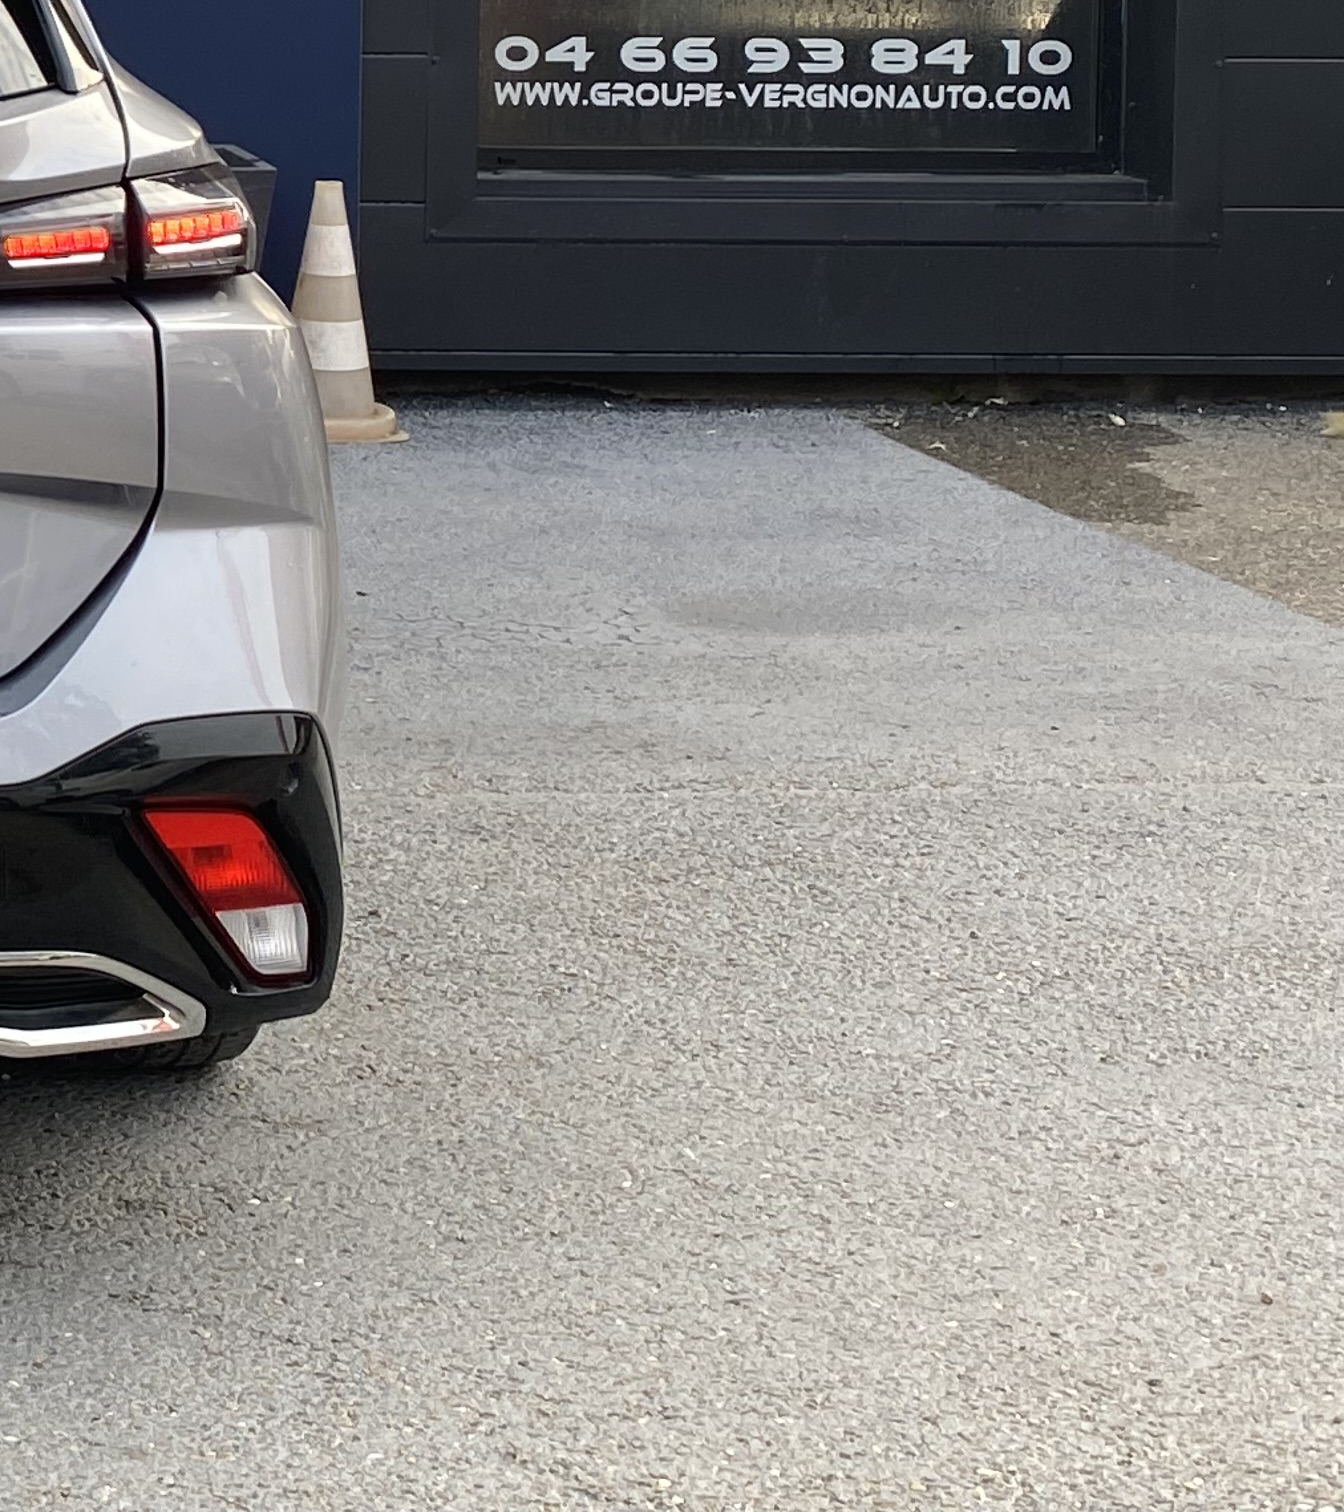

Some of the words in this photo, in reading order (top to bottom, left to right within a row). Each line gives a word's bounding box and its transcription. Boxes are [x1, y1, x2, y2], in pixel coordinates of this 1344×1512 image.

[494, 35, 595, 72] 04
[619, 36, 718, 73] 66
[744, 37, 844, 74] 93
[870, 38, 974, 75] 84
[1000, 39, 1073, 75] 10
[493, 81, 1071, 110] WWW.GROUPE-VERGNONAUTO.COM
